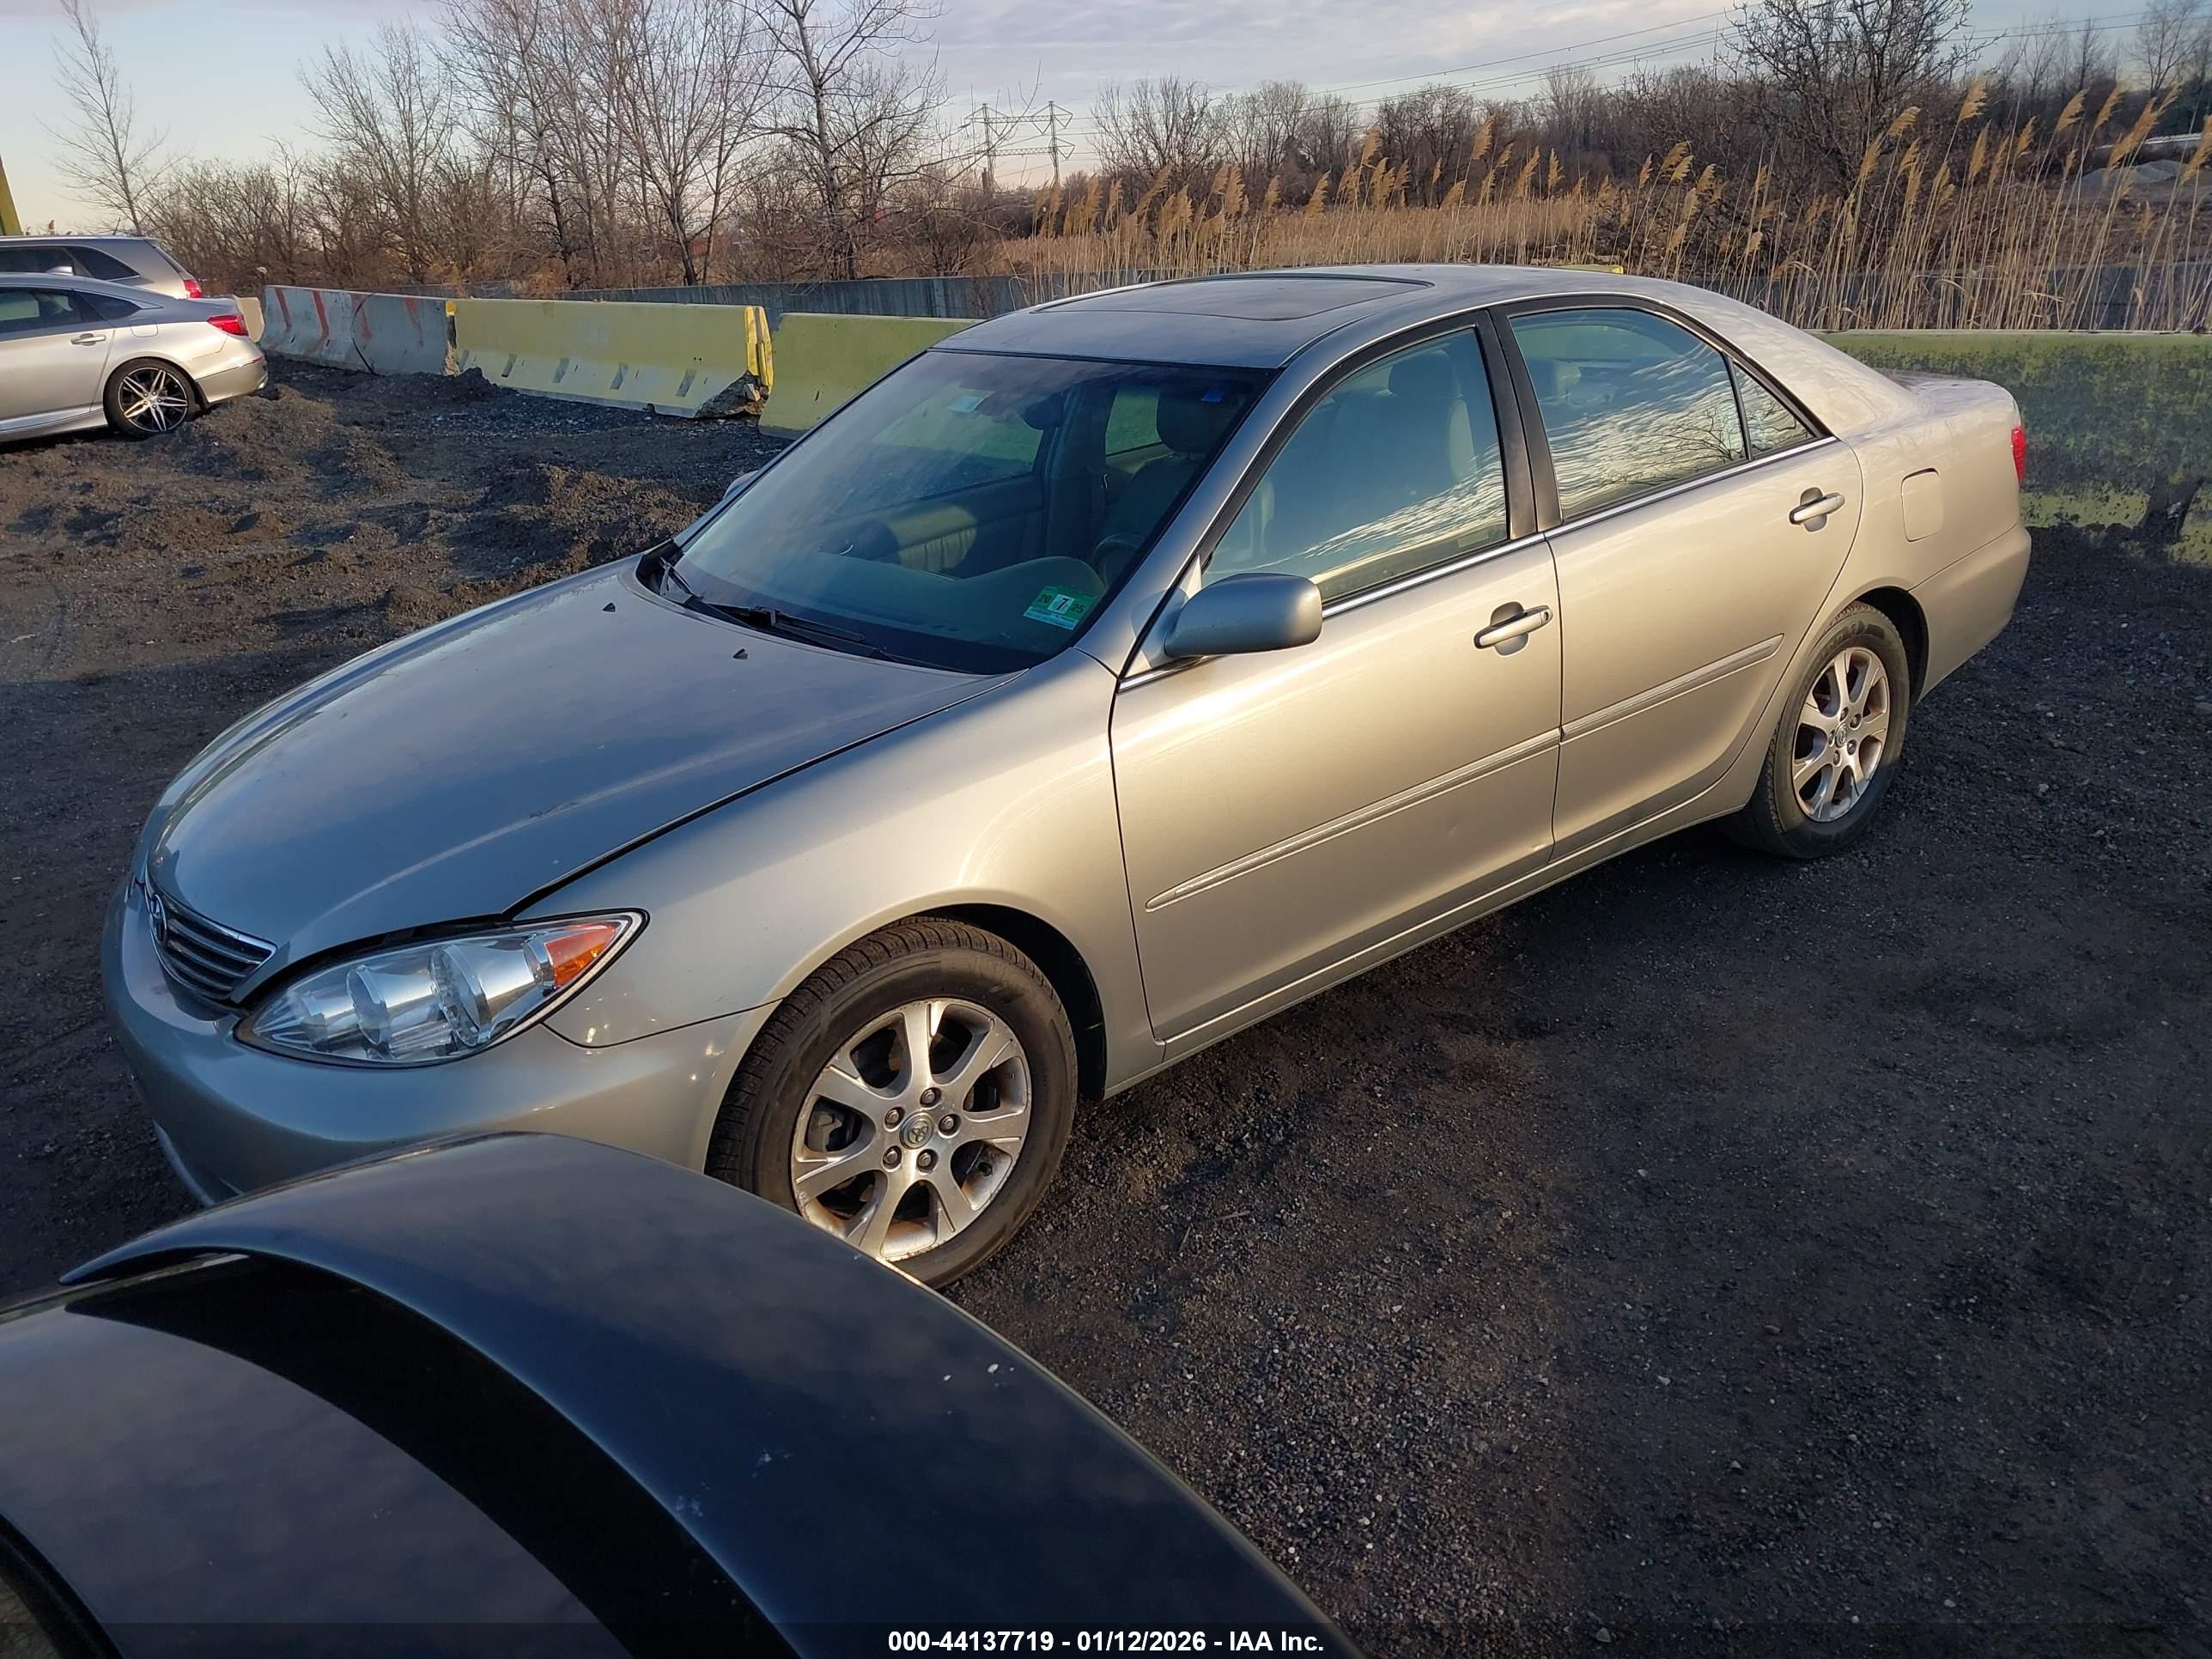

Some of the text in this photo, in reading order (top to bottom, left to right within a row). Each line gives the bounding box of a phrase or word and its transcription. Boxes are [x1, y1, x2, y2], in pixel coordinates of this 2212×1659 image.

[1038, 593, 1086, 613] 20 7 25
